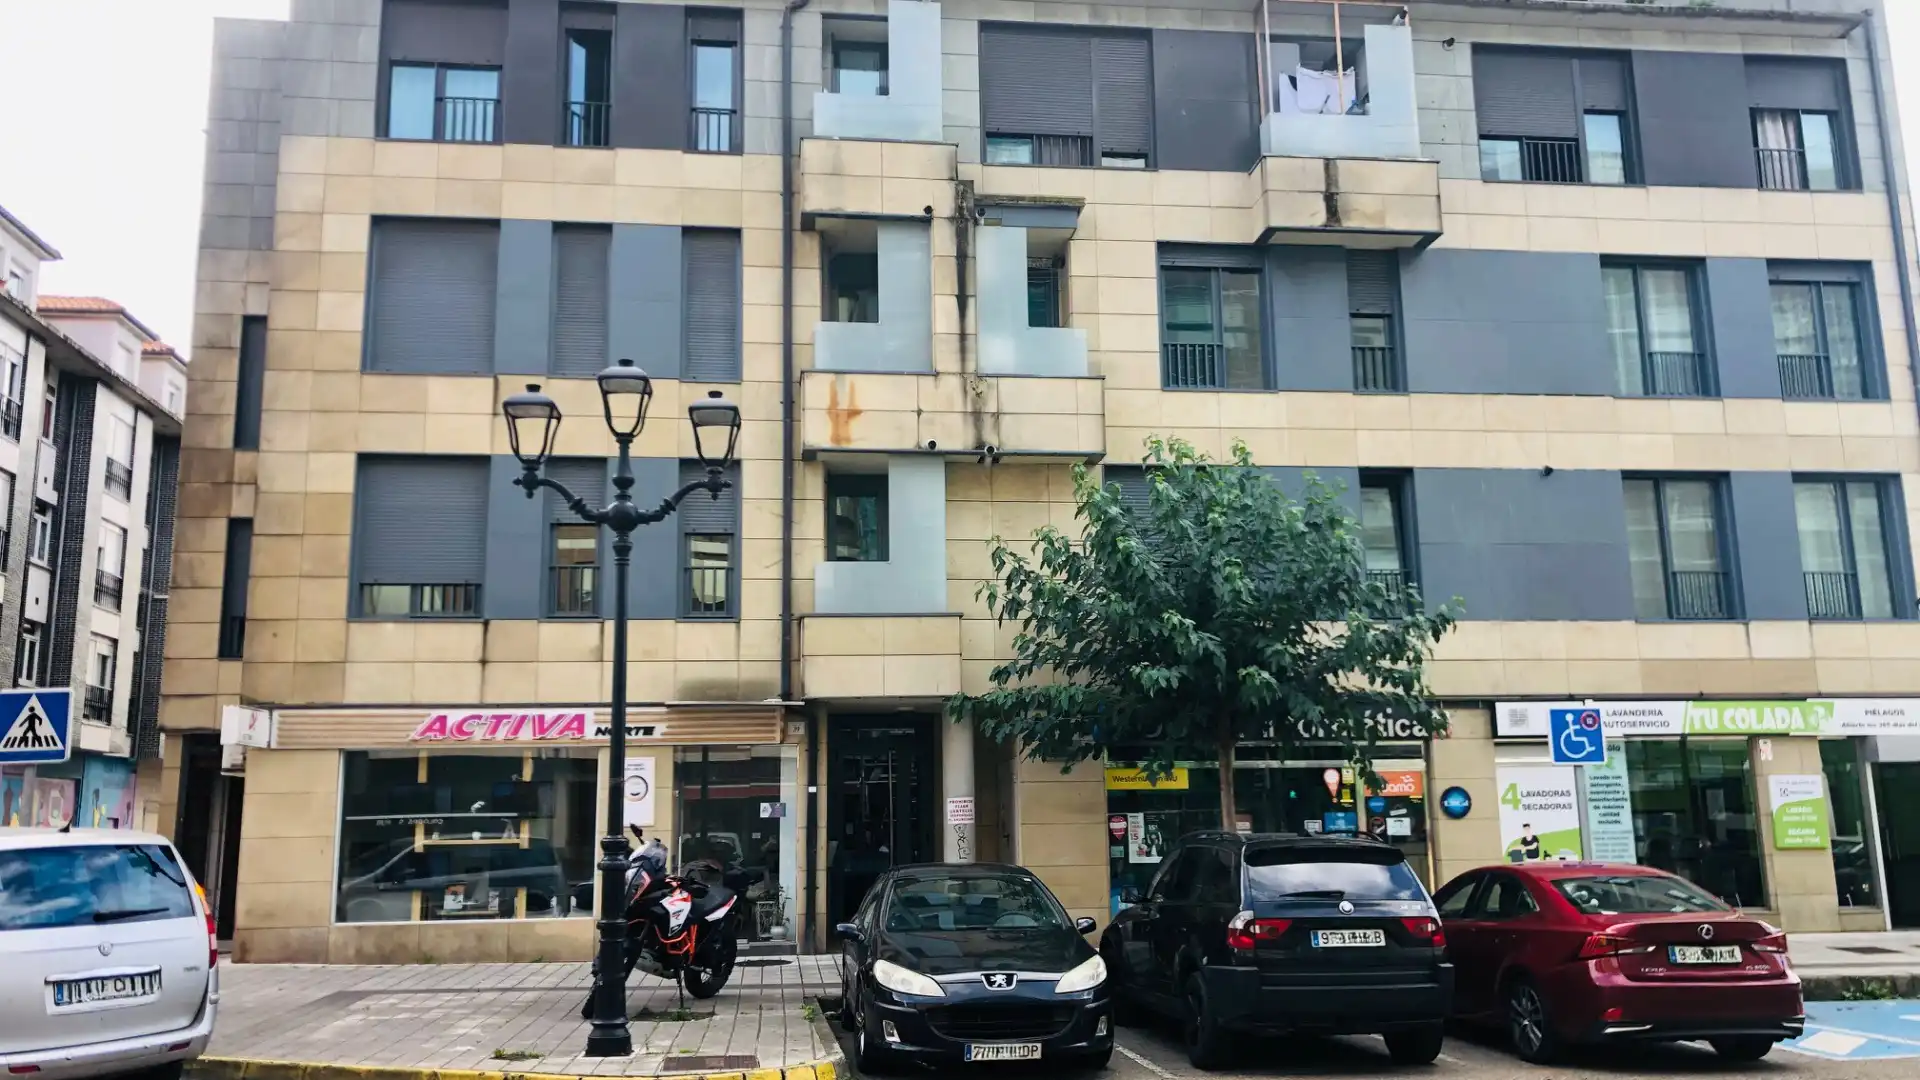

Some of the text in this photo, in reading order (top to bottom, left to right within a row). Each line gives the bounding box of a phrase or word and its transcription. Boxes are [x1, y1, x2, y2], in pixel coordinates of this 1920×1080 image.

[1606, 708, 1664, 717] LAVANDERÍA
[1688, 706, 1804, 730] TU COLADA
[415, 713, 587, 740] ACTIVA
[1501, 783, 1572, 811] 4 LAVADORAS
[1521, 803, 1573, 811] SECADORAS
